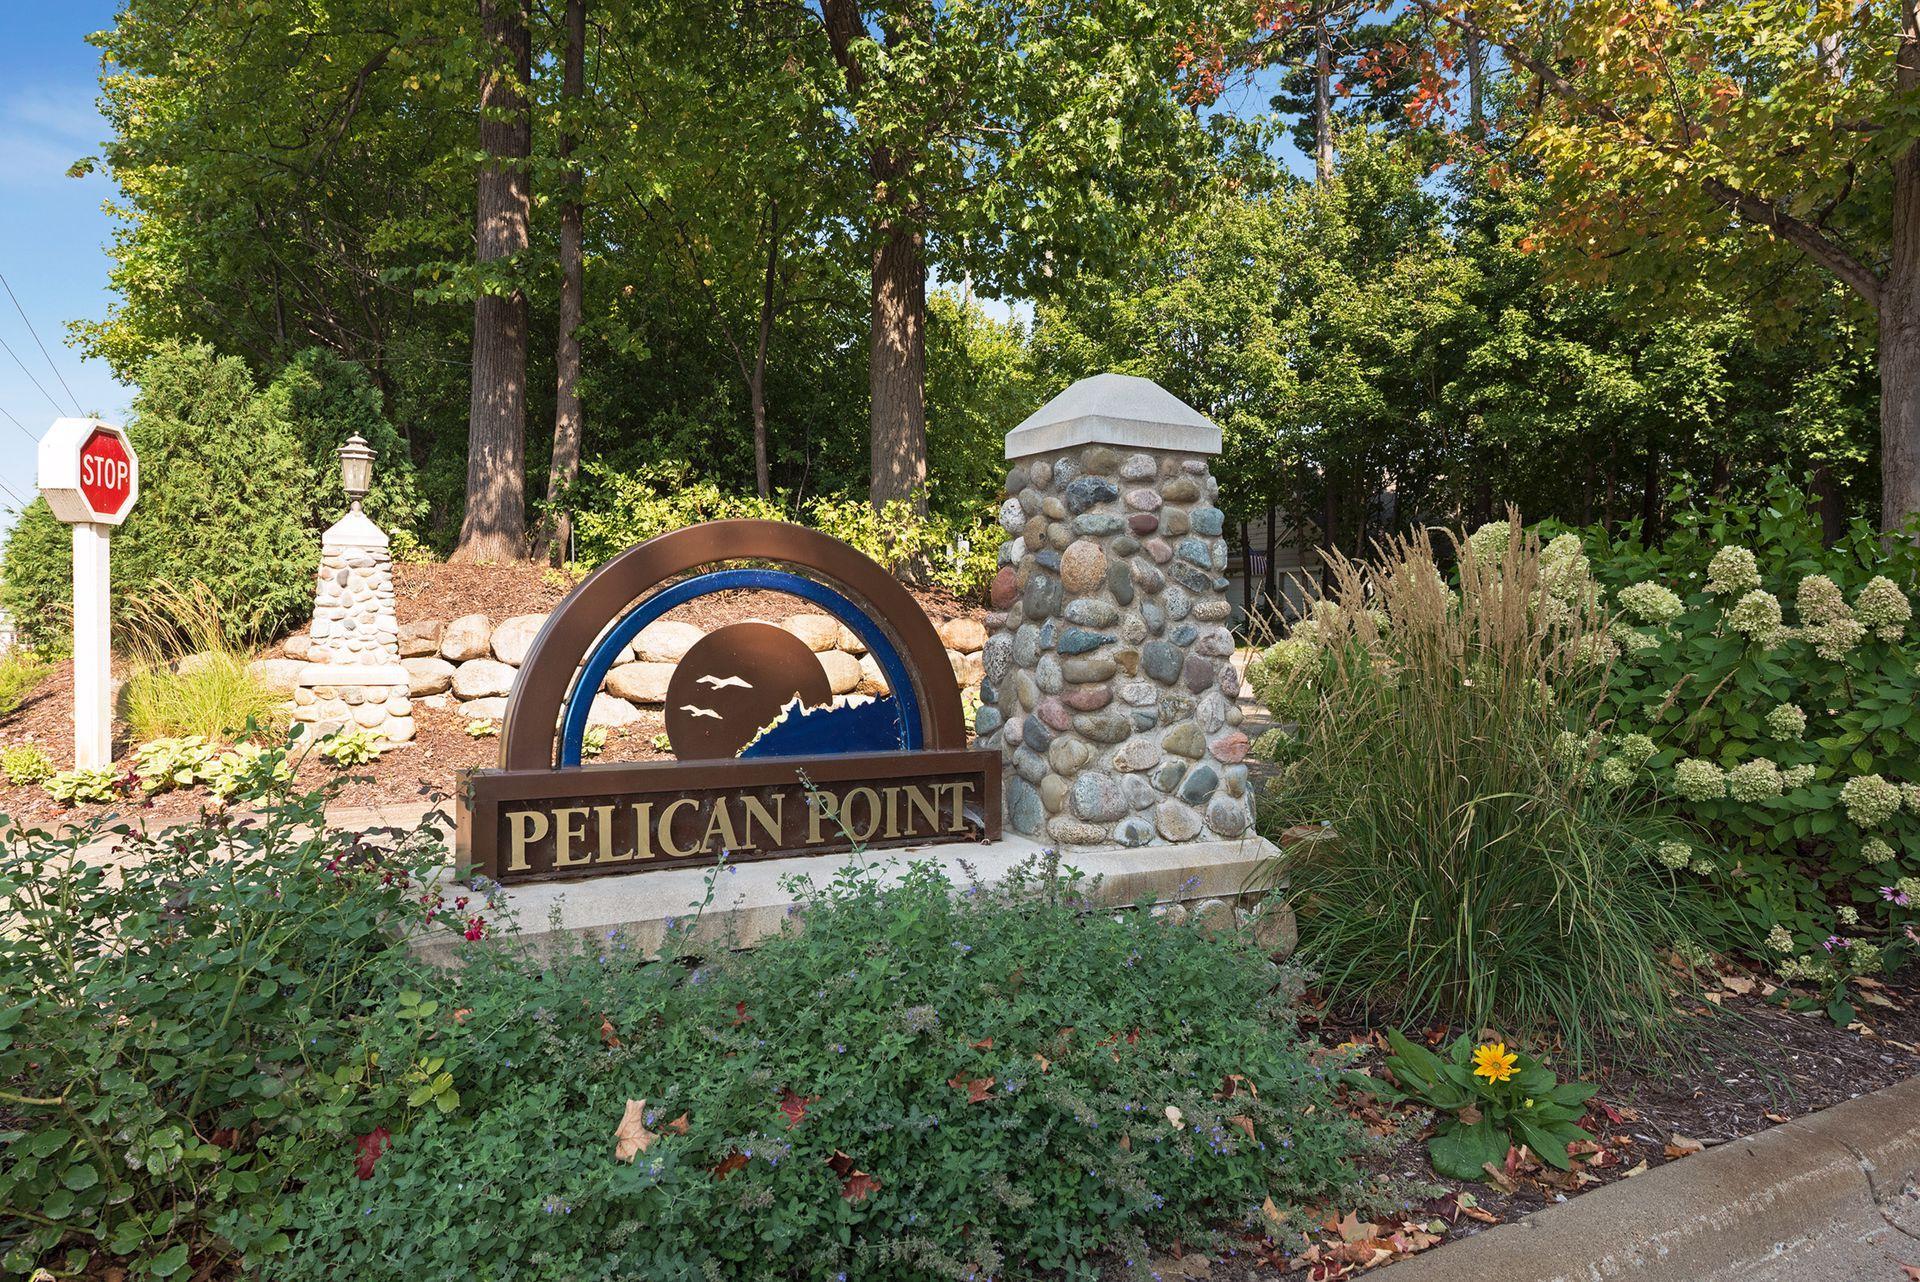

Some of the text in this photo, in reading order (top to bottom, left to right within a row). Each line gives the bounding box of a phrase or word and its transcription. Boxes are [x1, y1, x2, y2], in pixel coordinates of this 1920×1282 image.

[82, 453, 129, 490] STOP
[505, 781, 976, 872] PELICAN POINT
